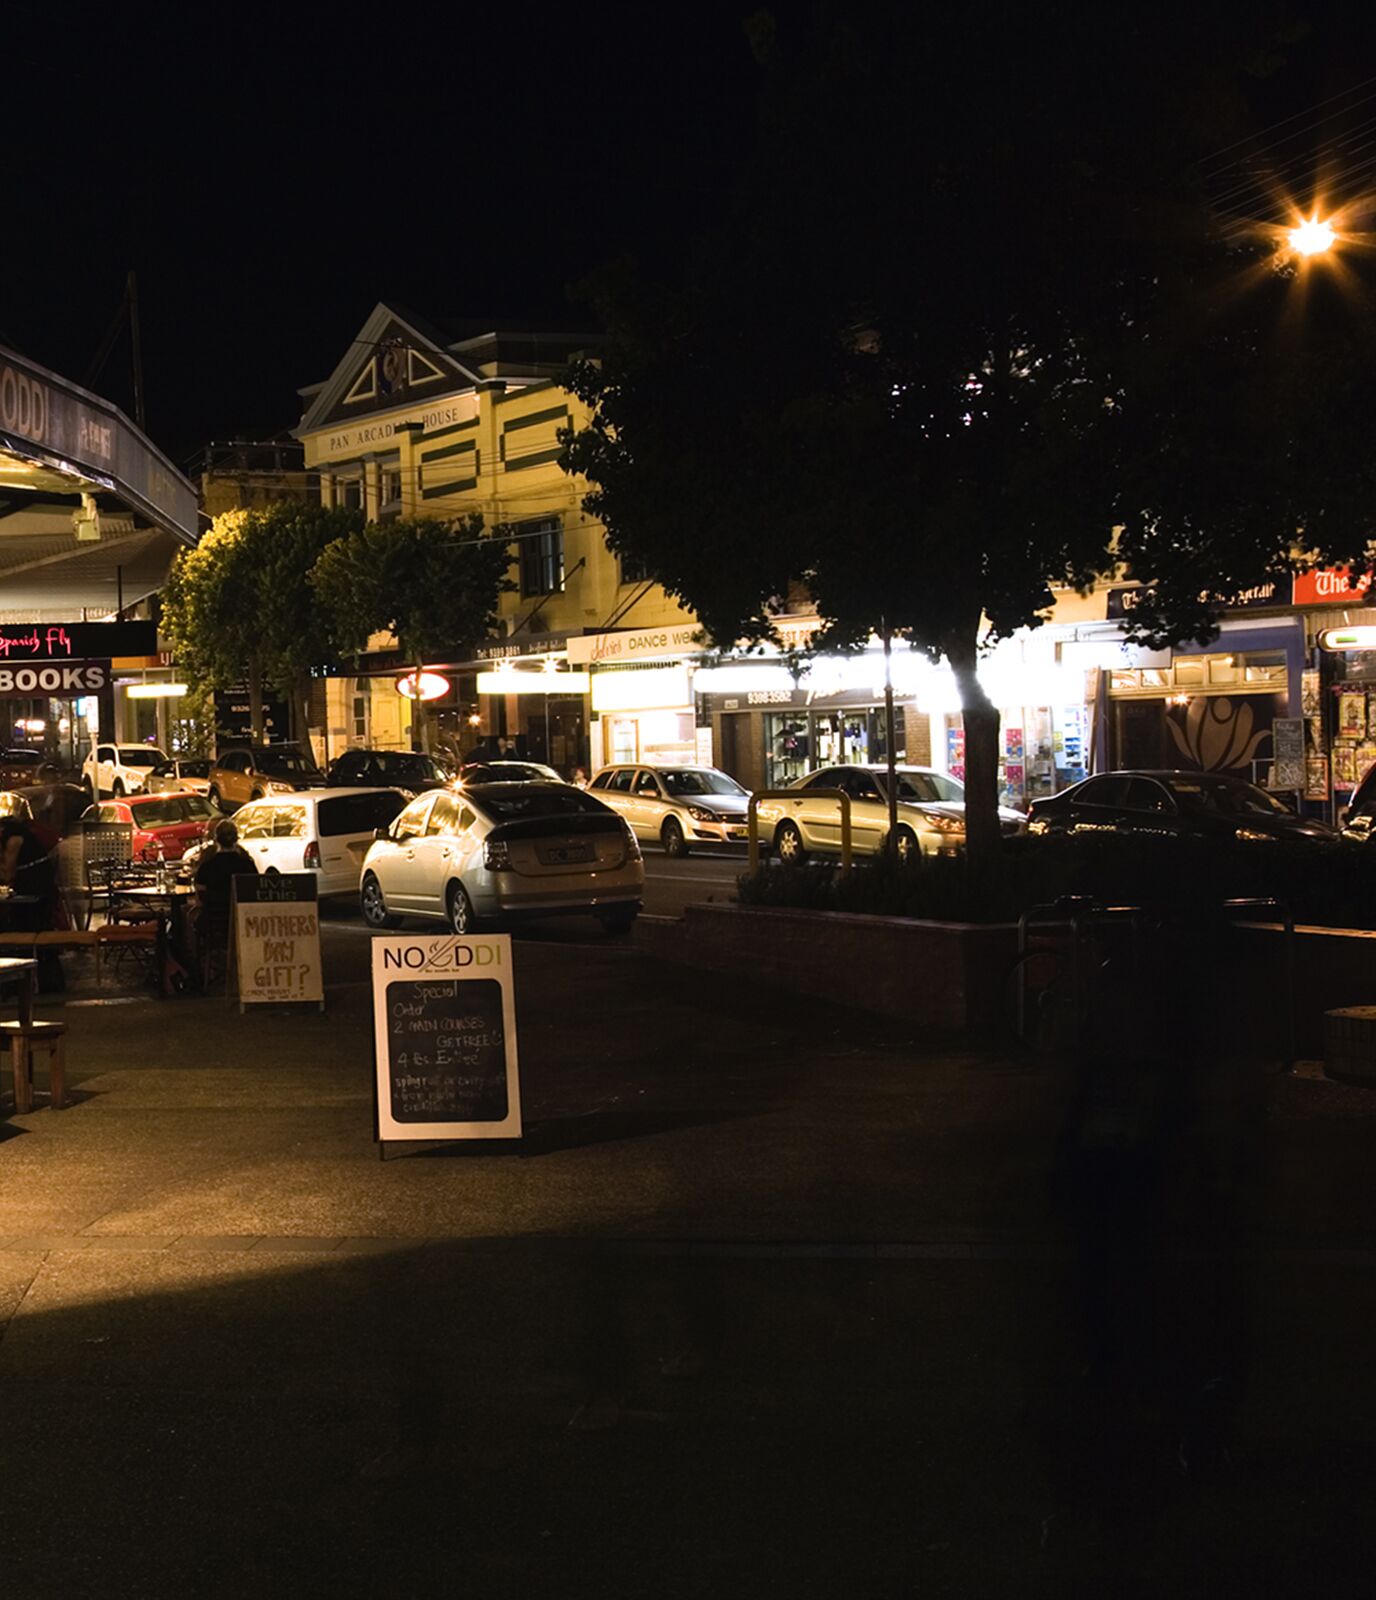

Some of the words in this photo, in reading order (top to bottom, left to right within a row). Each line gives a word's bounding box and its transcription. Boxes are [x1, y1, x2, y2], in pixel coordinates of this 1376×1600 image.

[330, 434, 350, 451] PAN
[356, 419, 411, 443] ARCADI
[422, 407, 459, 428] HOUSE
[1315, 572, 1349, 596] The
[45, 627, 72, 656] Fly
[256, 889, 297, 900] this
[259, 877, 293, 889] live
[245, 914, 316, 938] MOTHERS
[263, 938, 295, 963] DAY
[393, 1021, 404, 1034] 2
[436, 1035, 463, 1049] GET
[464, 1033, 490, 1047] FREE
